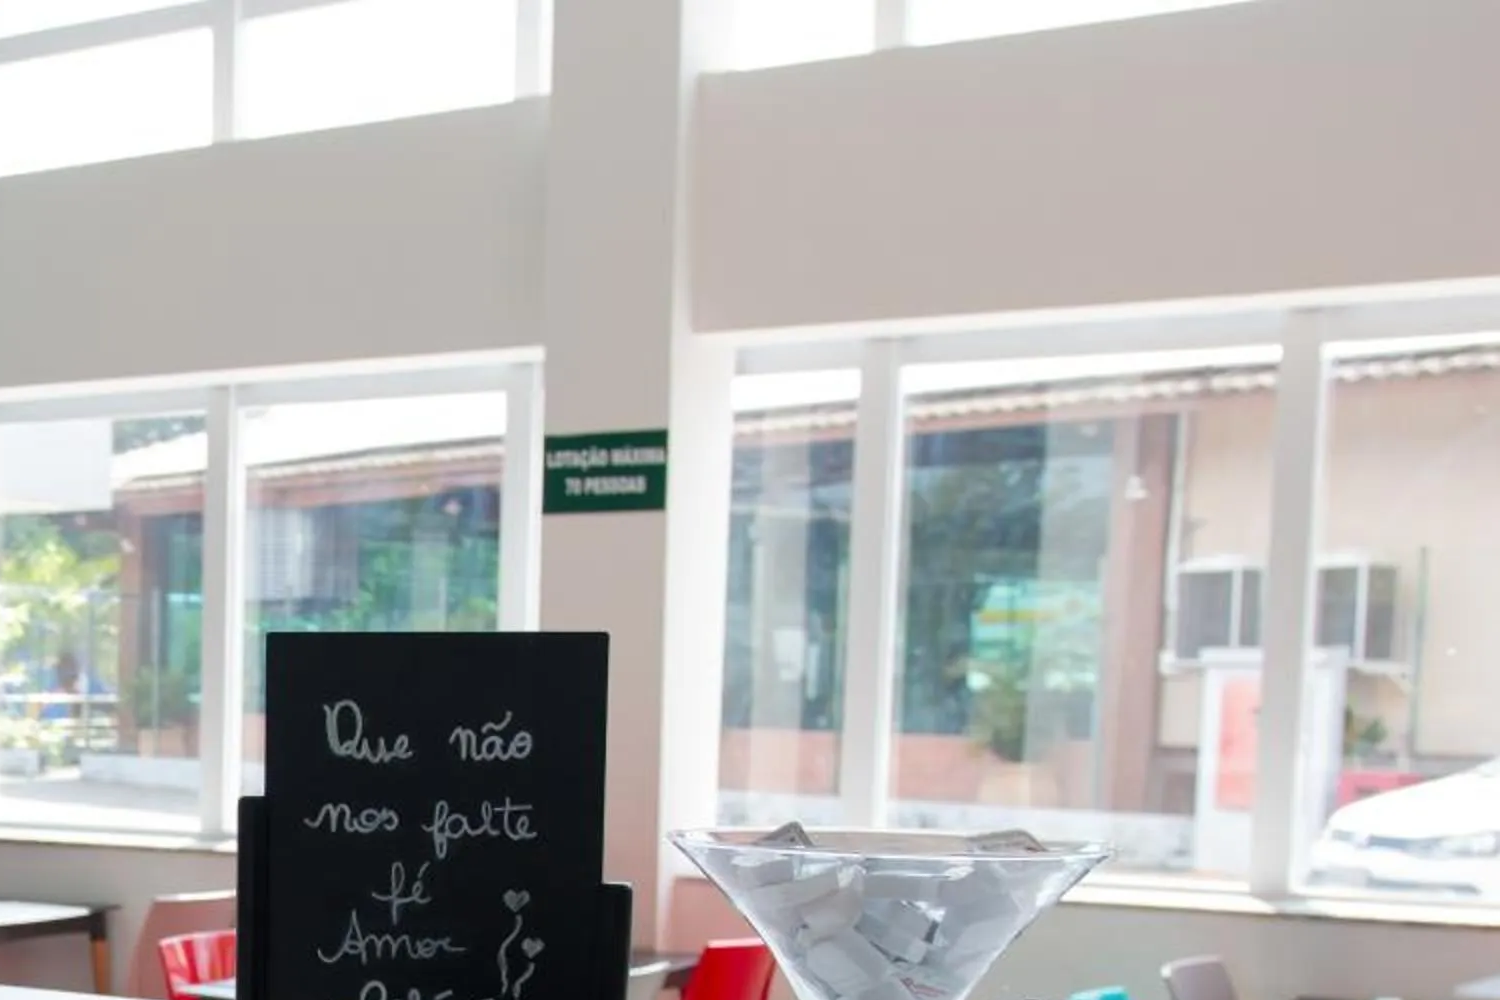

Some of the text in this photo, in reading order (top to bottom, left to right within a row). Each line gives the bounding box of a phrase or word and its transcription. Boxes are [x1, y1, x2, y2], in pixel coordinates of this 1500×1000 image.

[583, 475, 647, 495] PESSOAS
[323, 700, 534, 763] Que não
[304, 798, 537, 859] nos falte
[318, 909, 467, 965] Amor
